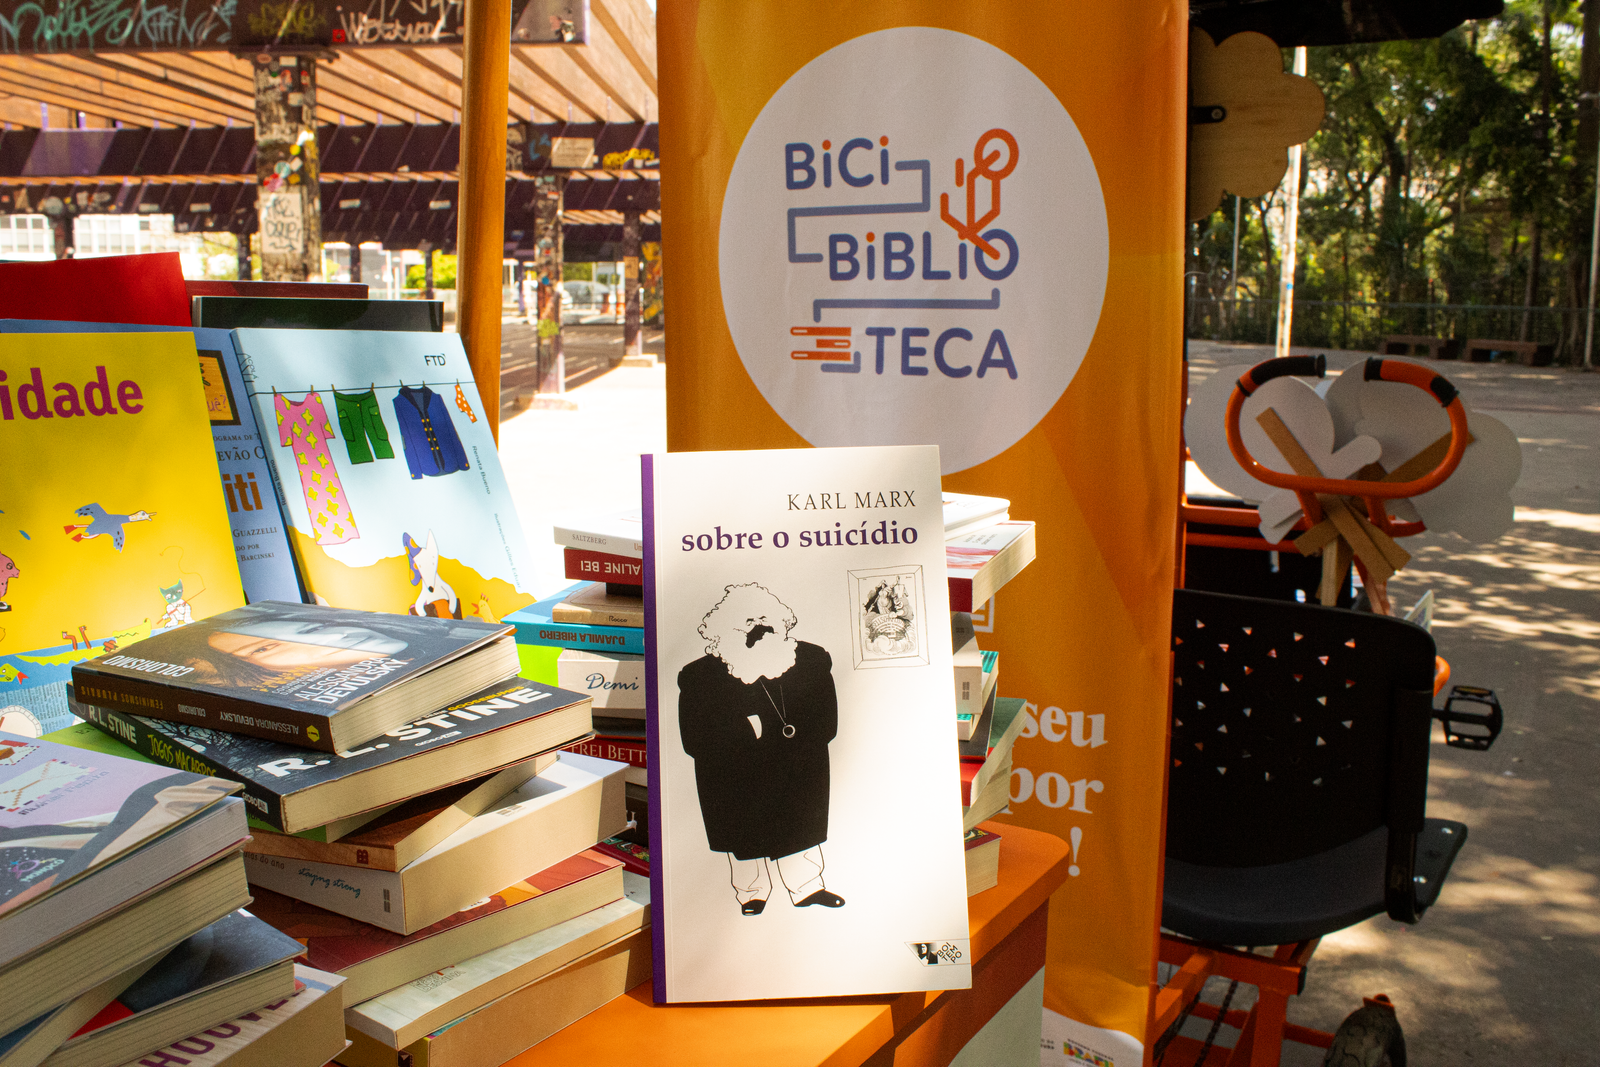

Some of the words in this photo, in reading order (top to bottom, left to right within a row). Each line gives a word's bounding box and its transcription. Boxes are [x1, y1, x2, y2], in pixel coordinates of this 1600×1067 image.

[424, 353, 447, 366] FTD
[865, 326, 1019, 380] TECA
[0, 365, 144, 420] idade
[222, 472, 263, 513] iti
[787, 492, 847, 511] KARL
[854, 490, 917, 508] MARX
[572, 533, 607, 546] SALTZBERG
[681, 525, 763, 552] sobre
[772, 530, 790, 549] o
[799, 520, 919, 547] suicídio
[580, 560, 600, 573] BEI
[604, 562, 641, 576] ALINE
[539, 629, 578, 642] RIBEIRO
[578, 632, 626, 645] DJAMILA
[102, 655, 195, 677] COLORISMO
[294, 657, 391, 701] ALESSANDRA
[311, 658, 409, 704] DEVULSKY
[585, 672, 639, 691] Demi
[219, 710, 255, 727] DEVULSKY
[385, 688, 553, 741] STINE
[107, 713, 138, 745] STINE
[255, 717, 300, 735] ALESSANDRA
[147, 734, 174, 764] JOGOS
[608, 744, 648, 763] BETT
[1068, 826, 1082, 877] !
[298, 867, 331, 888] staying
[332, 878, 361, 899] strong
